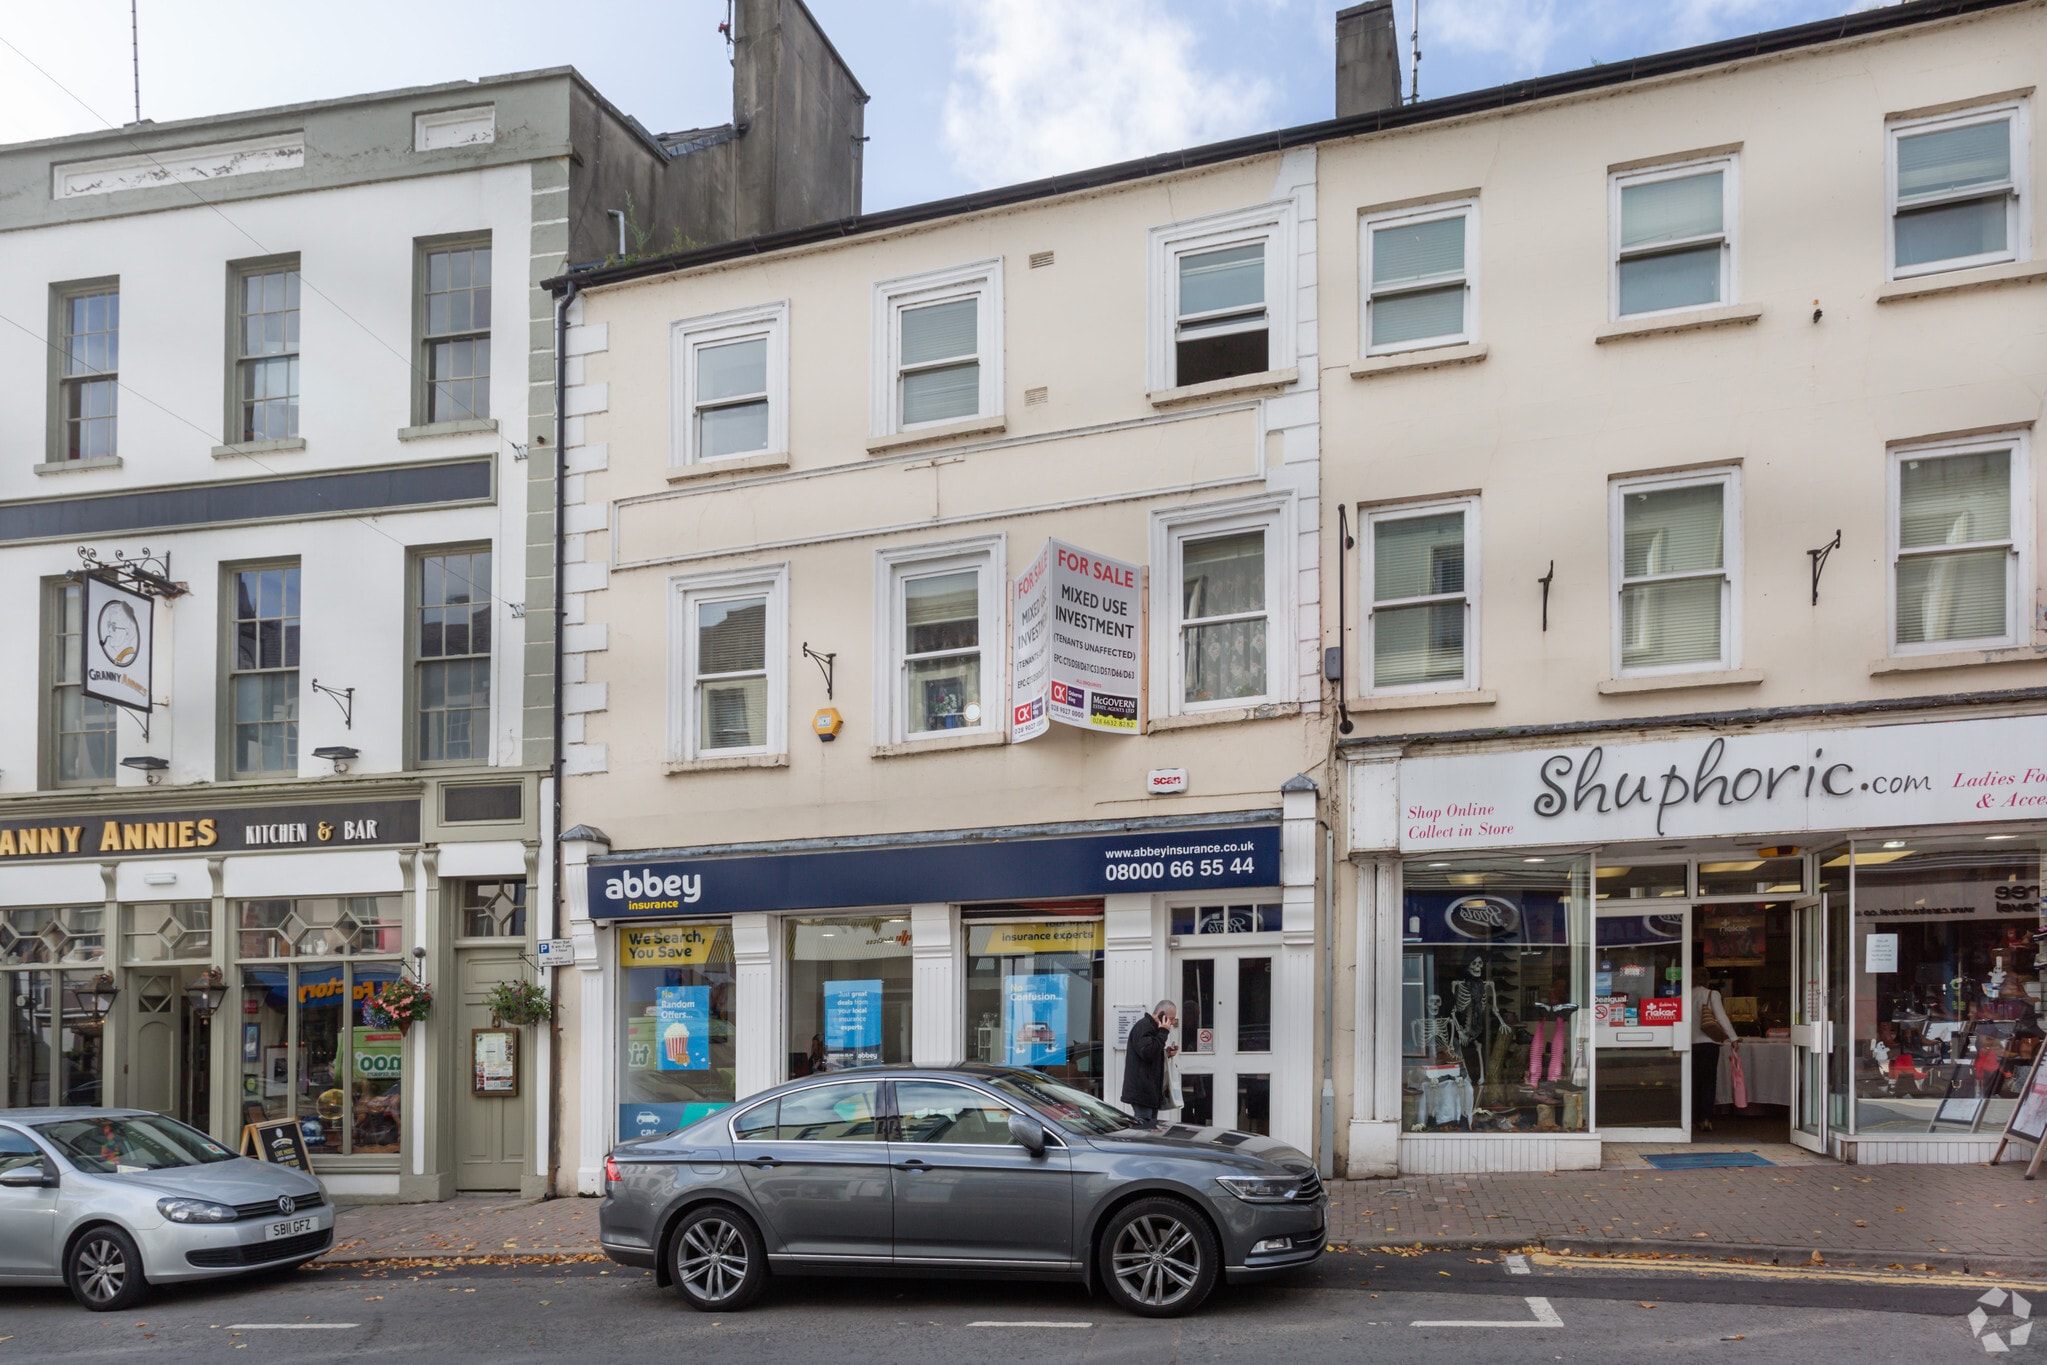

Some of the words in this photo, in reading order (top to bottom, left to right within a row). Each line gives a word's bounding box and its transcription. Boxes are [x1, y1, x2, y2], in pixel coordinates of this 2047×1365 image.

[1058, 549, 1089, 576] FOR
[1093, 561, 1134, 588] SALE
[1062, 584, 1099, 609] MIXED
[1102, 597, 1128, 616] USE
[1055, 605, 1135, 639] INVESTMENT
[1053, 632, 1083, 650] (TENANTS
[1084, 642, 1136, 661] UNAFFECTED)
[1092, 695, 1136, 709] McGOVERN
[1952, 770, 2016, 789] Ladies
[2021, 767, 2047, 785] Fo
[1975, 792, 1995, 809] &
[1407, 805, 1442, 823] Shop
[1446, 802, 1495, 818] Online
[99, 818, 218, 851] ANNIES
[245, 822, 307, 845] KITCHEN
[317, 820, 335, 841] &
[344, 819, 378, 840] BAR
[1408, 824, 1454, 840] Collect
[1458, 823, 1473, 837] in
[1478, 821, 1514, 836] Store
[1105, 841, 1254, 859] www.abbeyinsurance.co.uk
[1105, 862, 1164, 882] 08000
[1169, 860, 1194, 879] 66
[1200, 858, 1224, 877] 55
[1229, 856, 1255, 875] 44
[605, 868, 702, 903] abbey
[628, 900, 679, 911] insurance
[628, 934, 651, 945] We
[654, 930, 706, 944] Search,
[1002, 932, 1051, 941] insurance
[1053, 930, 1094, 941] experts
[629, 947, 654, 959] You
[658, 946, 692, 958] Save
[662, 990, 673, 998] No
[851, 991, 868, 1000] great
[1010, 984, 1023, 993] No
[662, 1001, 695, 1009] Random
[661, 1011, 693, 1019] Offers...
[840, 1024, 865, 1032] experts.
[294, 1219, 311, 1232] GFZ
